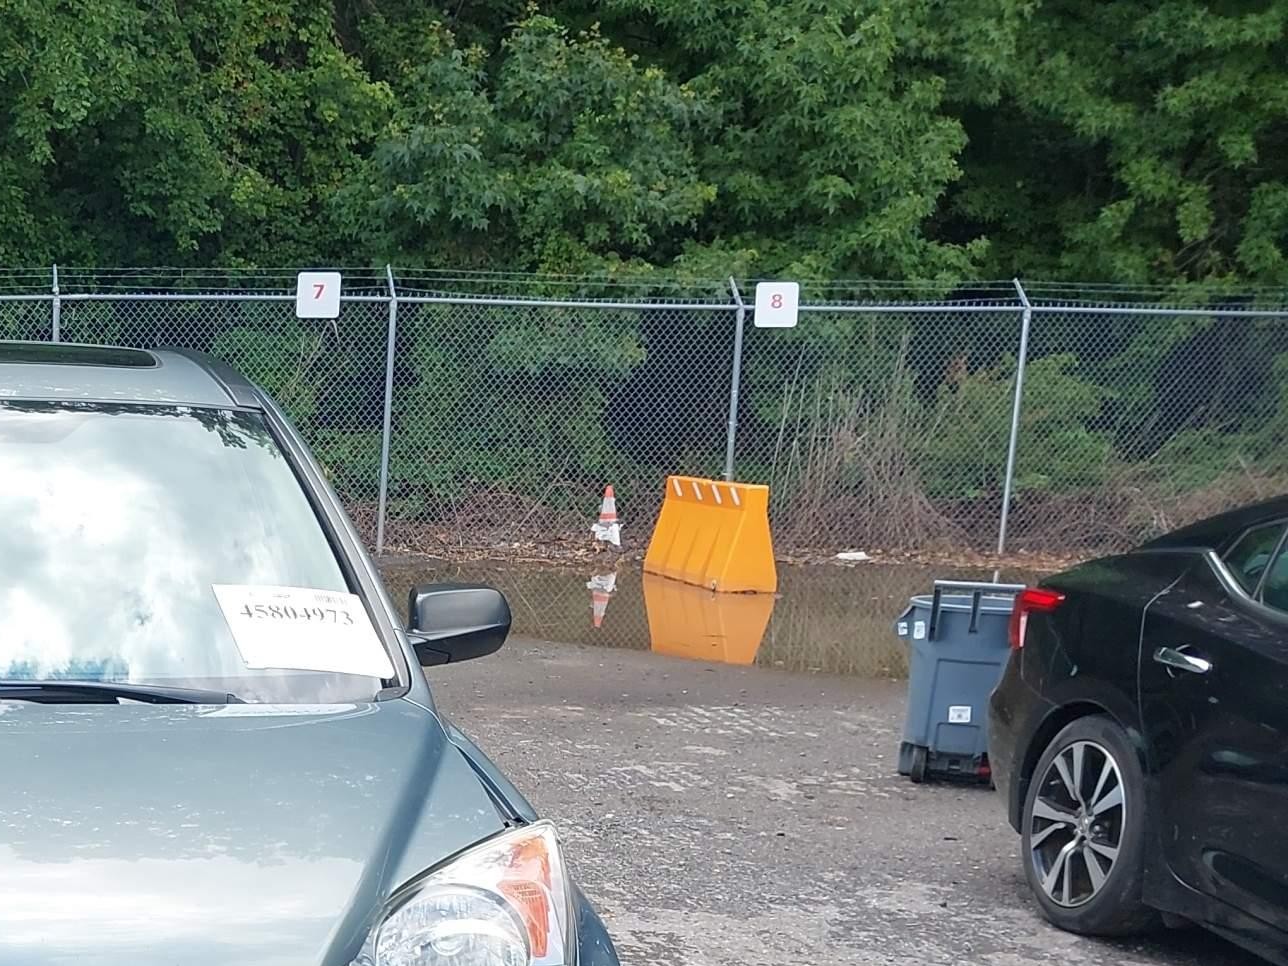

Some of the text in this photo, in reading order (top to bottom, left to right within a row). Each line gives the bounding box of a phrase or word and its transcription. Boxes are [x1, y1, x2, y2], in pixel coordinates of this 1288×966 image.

[312, 283, 325, 300] 7
[770, 293, 783, 309] 8
[240, 603, 354, 626] 45804973
